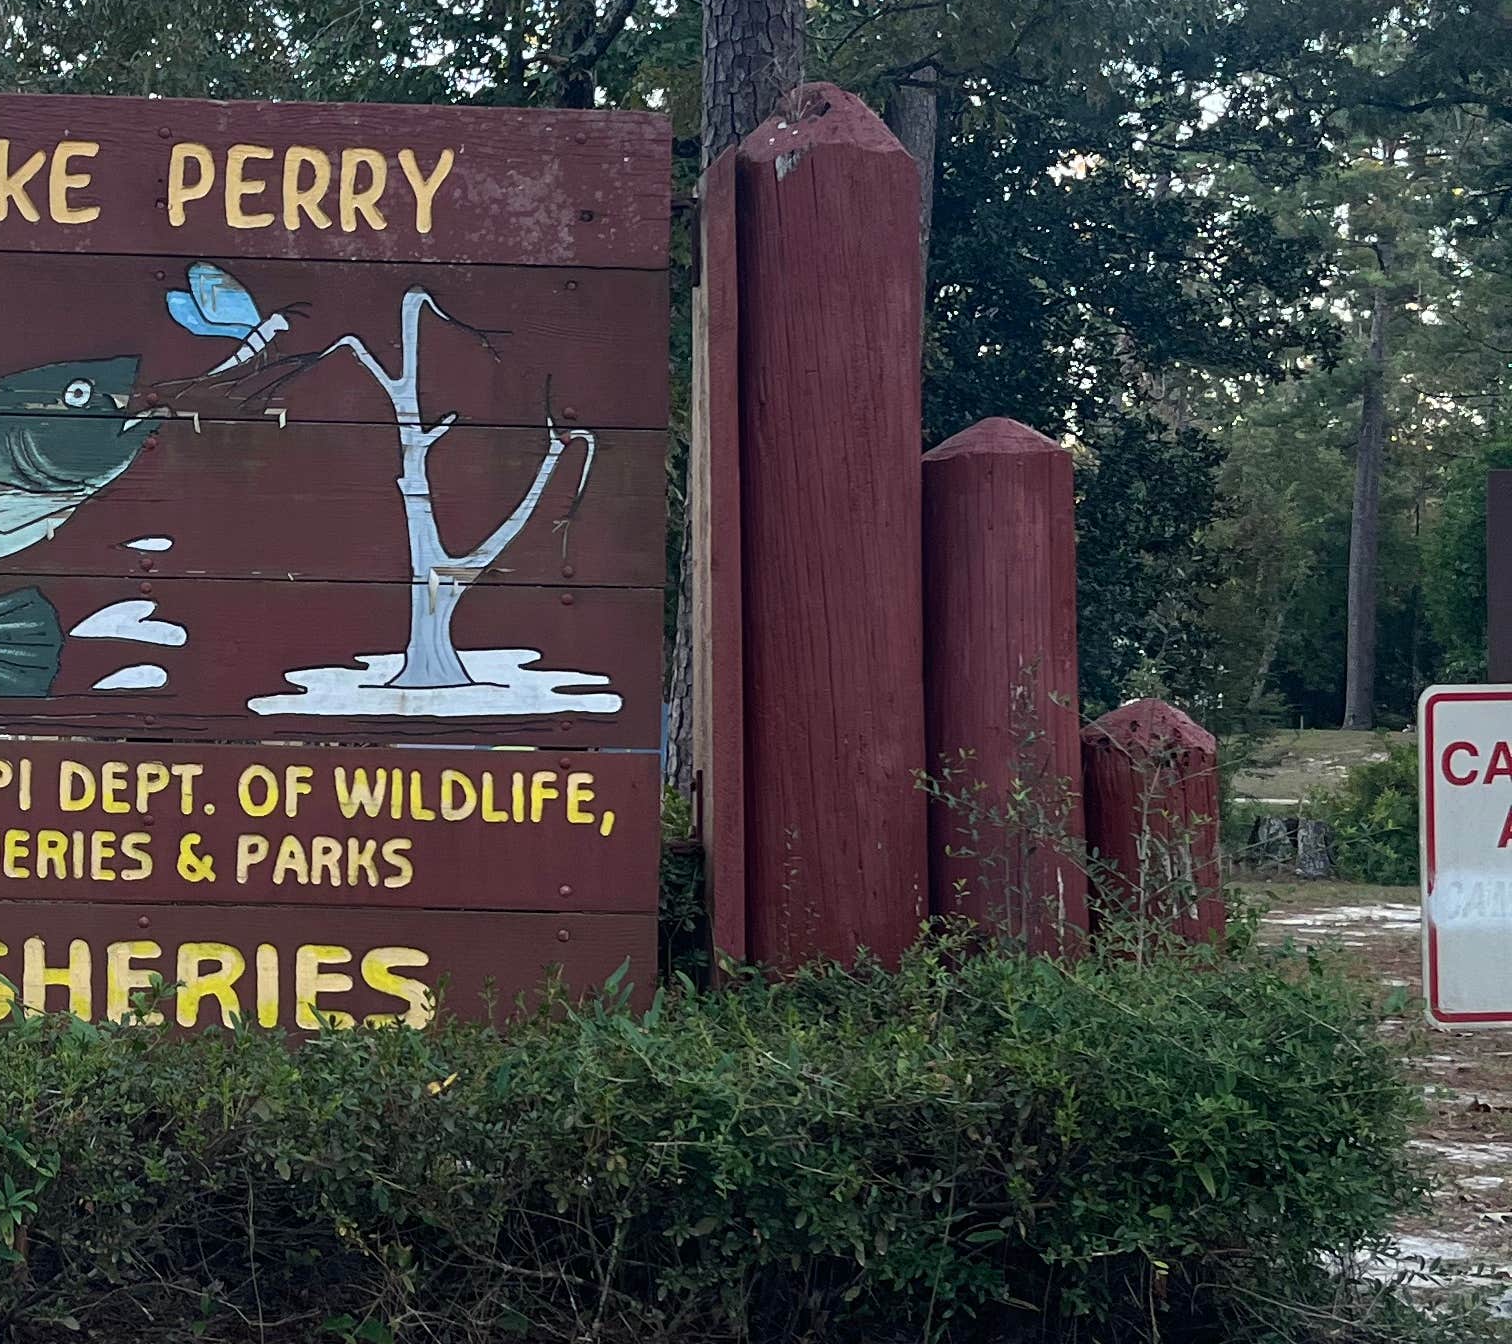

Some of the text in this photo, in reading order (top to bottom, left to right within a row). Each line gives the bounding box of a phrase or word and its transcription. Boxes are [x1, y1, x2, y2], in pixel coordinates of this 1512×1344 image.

[167, 142, 455, 234] PERRY
[59, 760, 216, 816] DEPT.
[237, 764, 314, 818] OF
[334, 766, 616, 837] WILDLIFE,
[176, 832, 217, 883] &
[236, 834, 413, 889] PARKS
